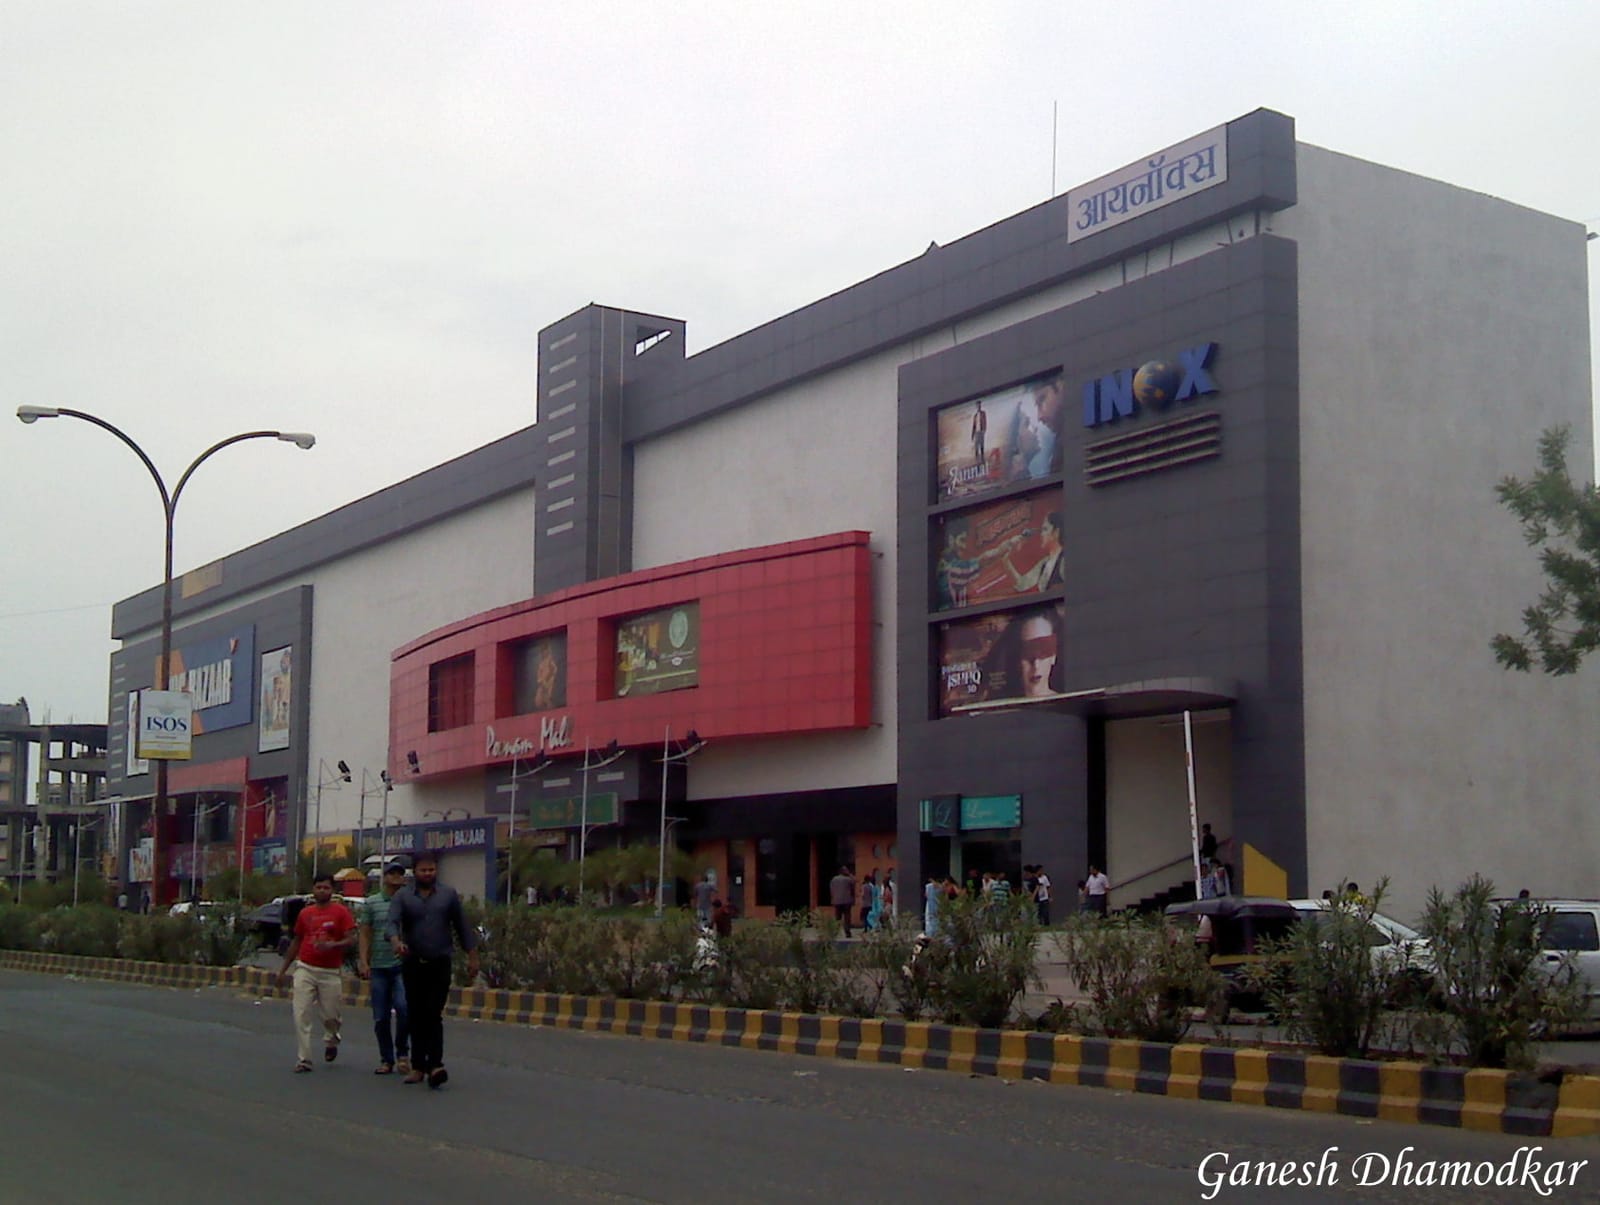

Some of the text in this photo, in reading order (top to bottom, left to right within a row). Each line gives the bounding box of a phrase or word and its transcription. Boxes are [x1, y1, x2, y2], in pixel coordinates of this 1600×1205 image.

[1076, 144, 1217, 230] आयनॉक्स
[1082, 342, 1219, 428] INOX
[146, 715, 188, 732] ISOS
[455, 828, 486, 847] BAZAAR
